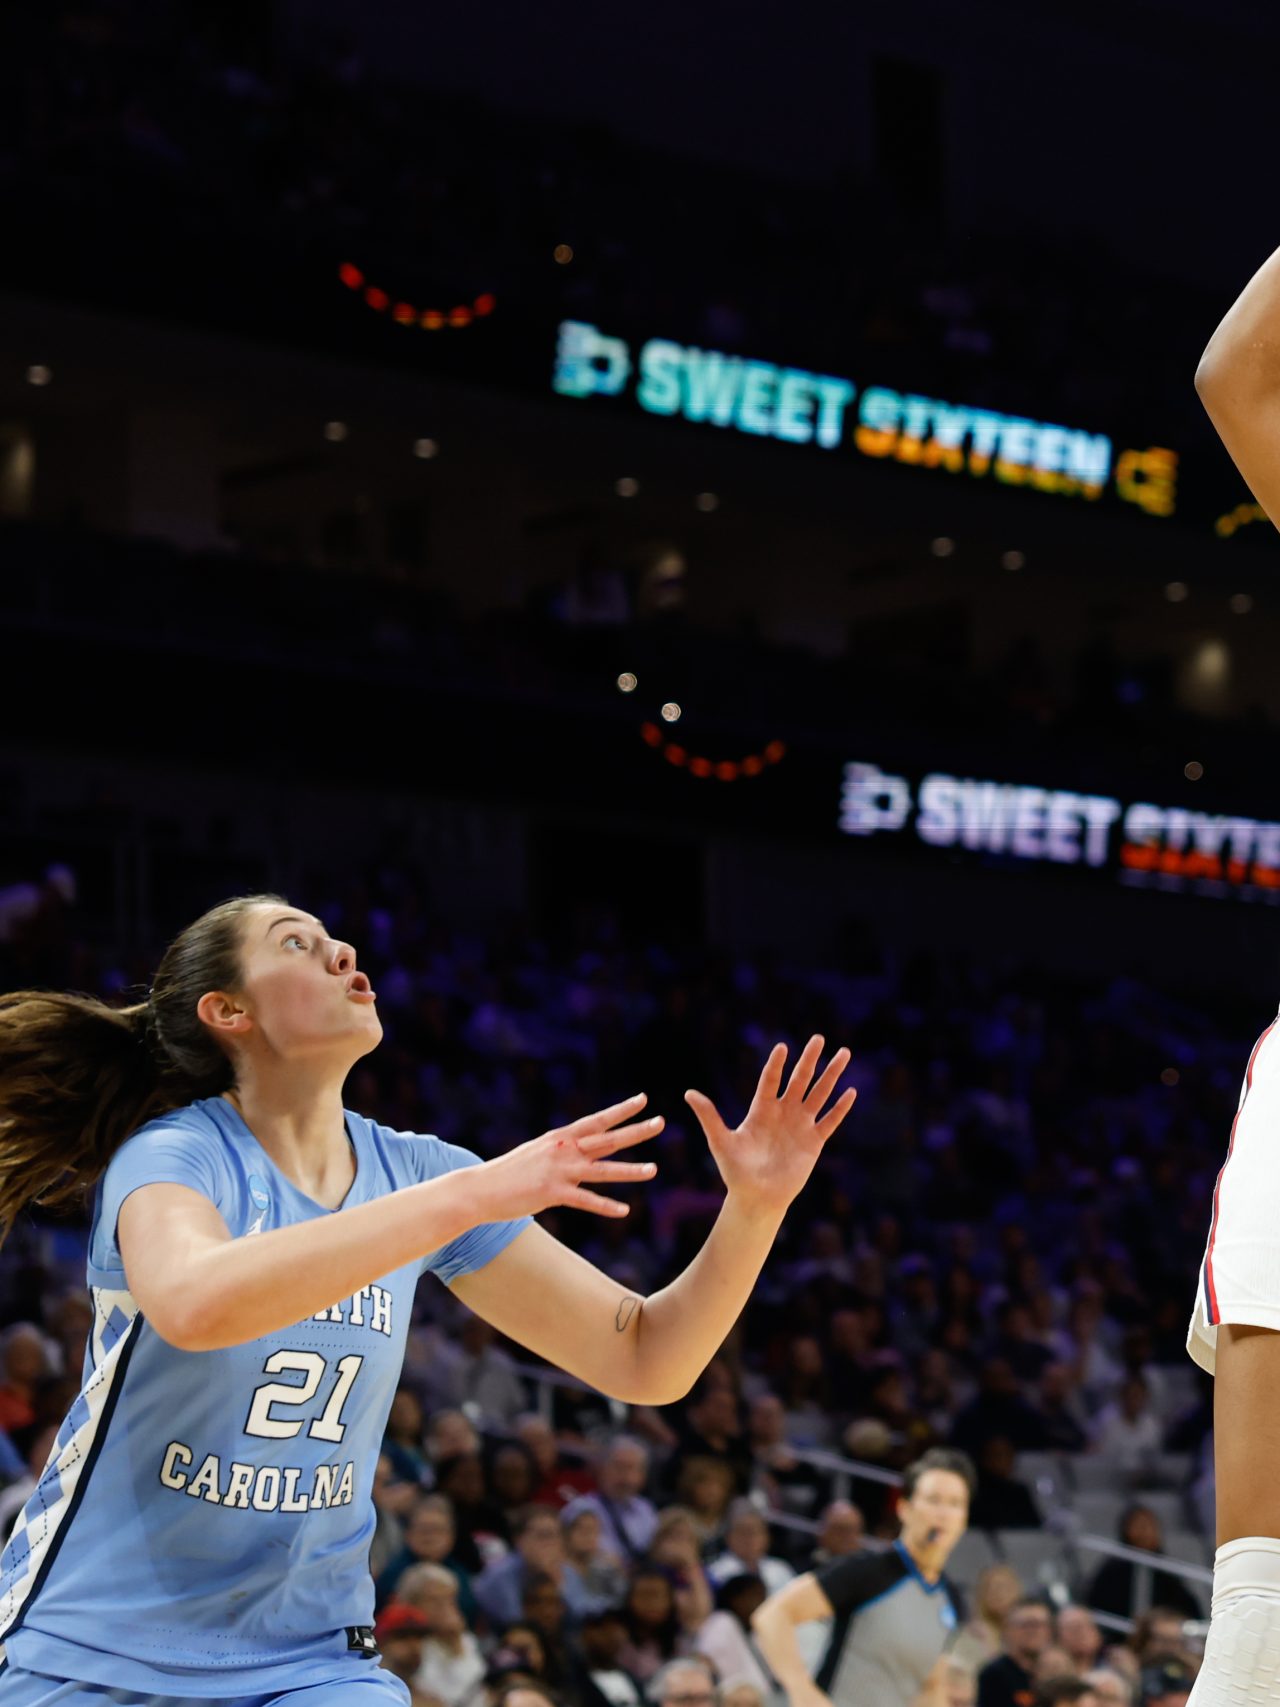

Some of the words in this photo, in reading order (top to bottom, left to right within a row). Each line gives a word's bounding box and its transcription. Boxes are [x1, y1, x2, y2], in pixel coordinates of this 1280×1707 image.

[637, 337, 857, 450] SWEET
[854, 385, 1112, 500] SIXTEEN
[916, 772, 1120, 868] SWEET
[243, 1348, 364, 1444] 21
[159, 1440, 354, 1513] CAROLNA
